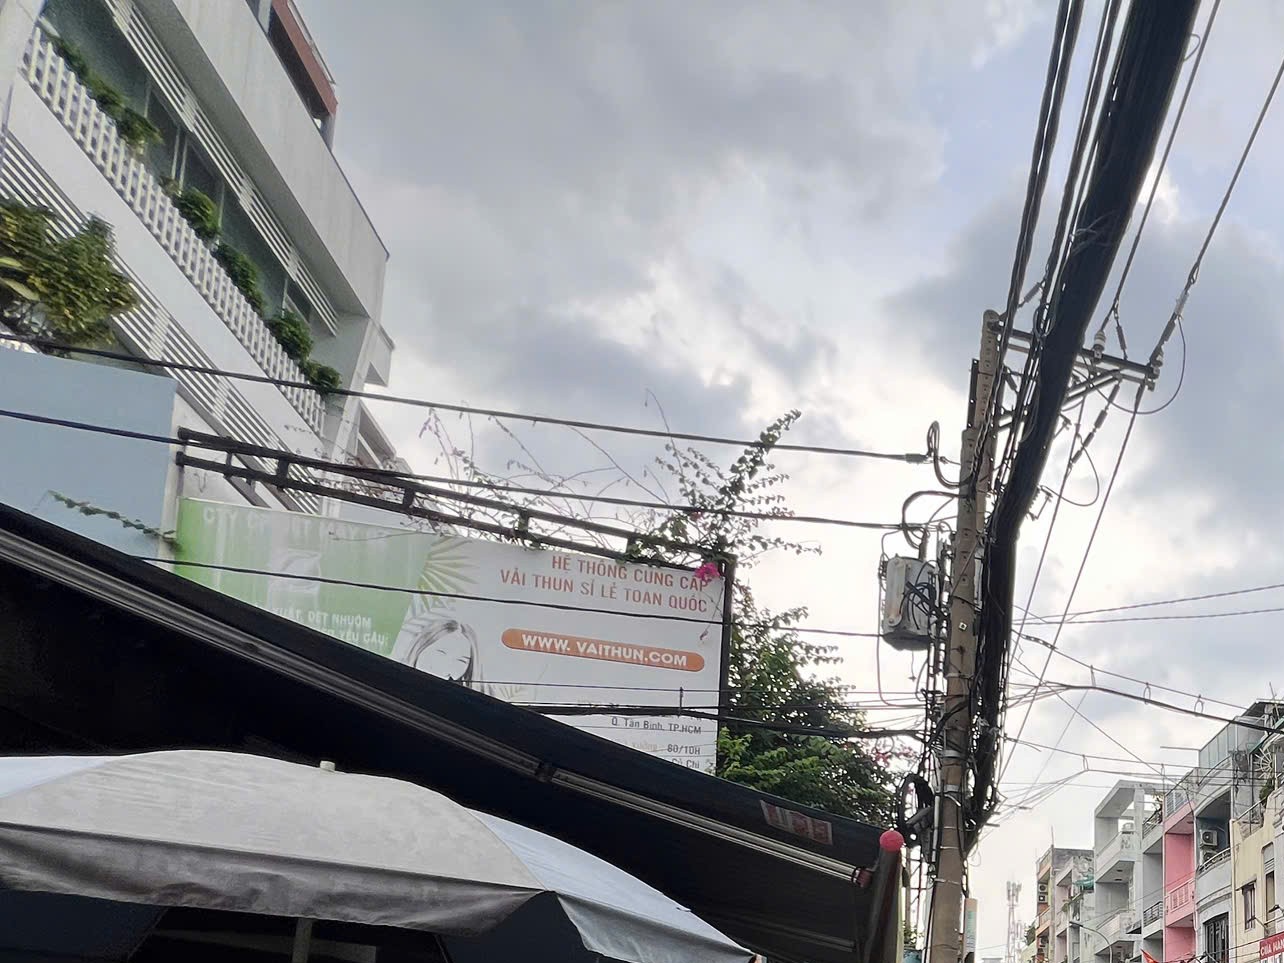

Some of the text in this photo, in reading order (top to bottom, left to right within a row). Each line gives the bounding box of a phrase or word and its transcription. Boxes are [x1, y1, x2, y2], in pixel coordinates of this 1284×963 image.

[500, 567, 526, 586] VẢI
[532, 573, 574, 593] THUN
[601, 582, 617, 600] LẺ
[669, 594, 708, 614] QUỐC
[553, 555, 571, 572] HỆ
[577, 558, 628, 581] THỐNG
[633, 568, 674, 588] CUNG
